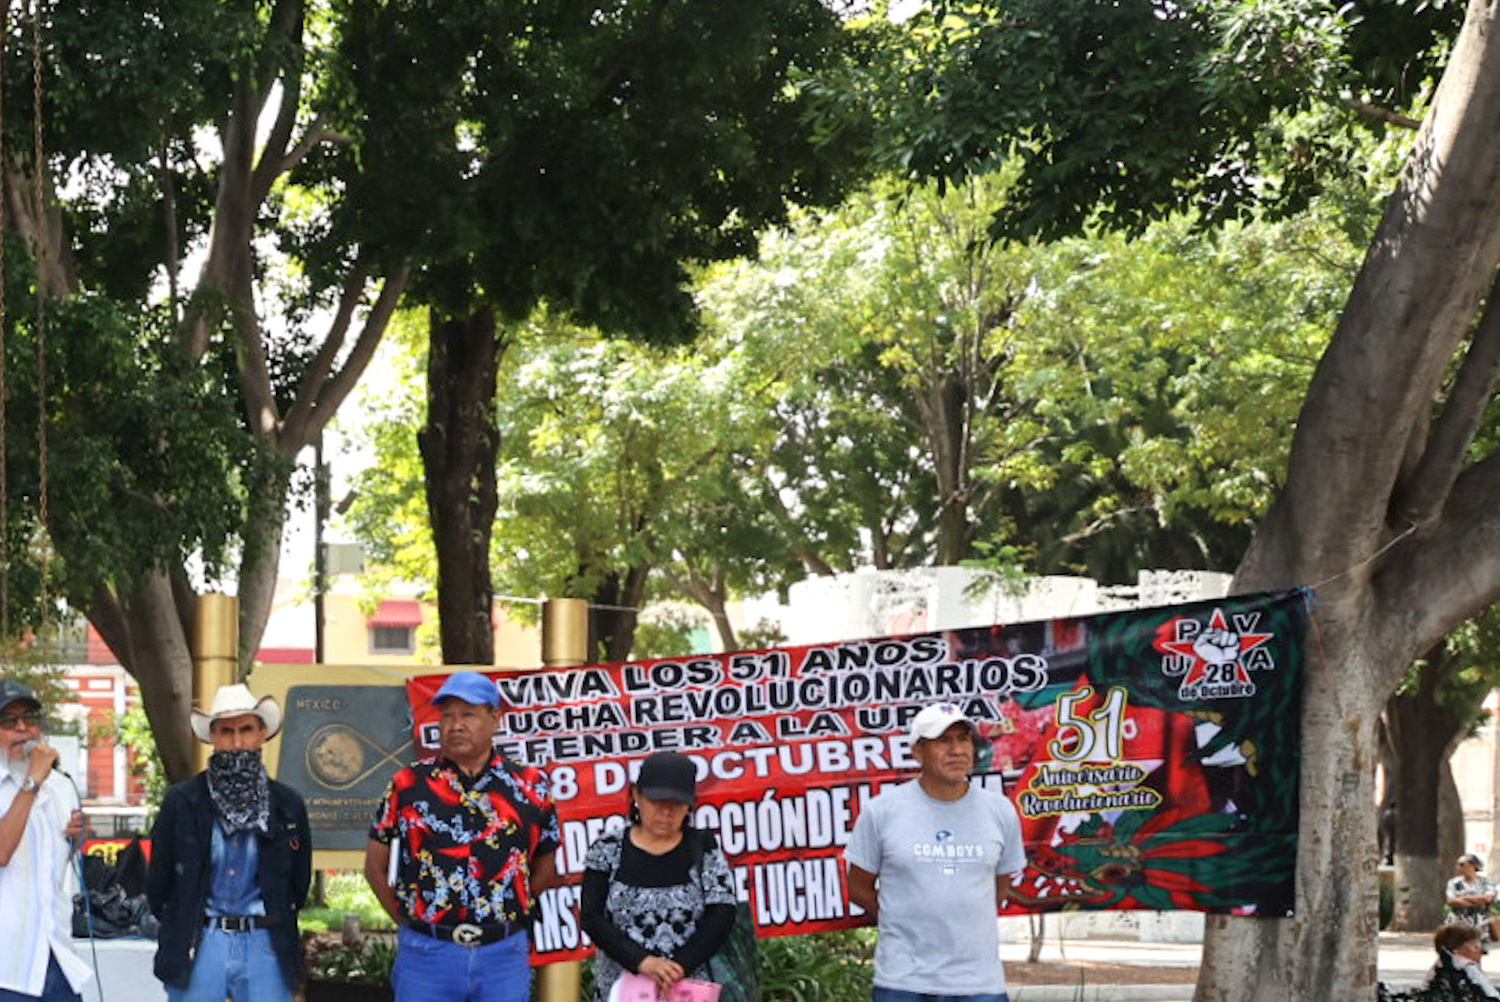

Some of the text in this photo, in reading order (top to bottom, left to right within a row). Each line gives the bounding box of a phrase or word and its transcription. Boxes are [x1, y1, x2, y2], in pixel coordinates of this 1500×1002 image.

[1177, 611, 1261, 642] P V
[1161, 648, 1275, 676] U A
[1205, 663, 1236, 684] 28
[499, 668, 615, 707] VIVA
[622, 657, 722, 692] LOS
[730, 652, 790, 683] 51
[633, 655, 1049, 725] REVOLUCIONARIOS
[1201, 683, 1257, 699] Octubre
[498, 698, 1003, 764] EFENDER A LA UPA
[1050, 686, 1129, 762] 51
[1031, 762, 1145, 788] Aniversario
[1019, 789, 1162, 816] Revolucionario
[756, 857, 846, 926] LUCHA
